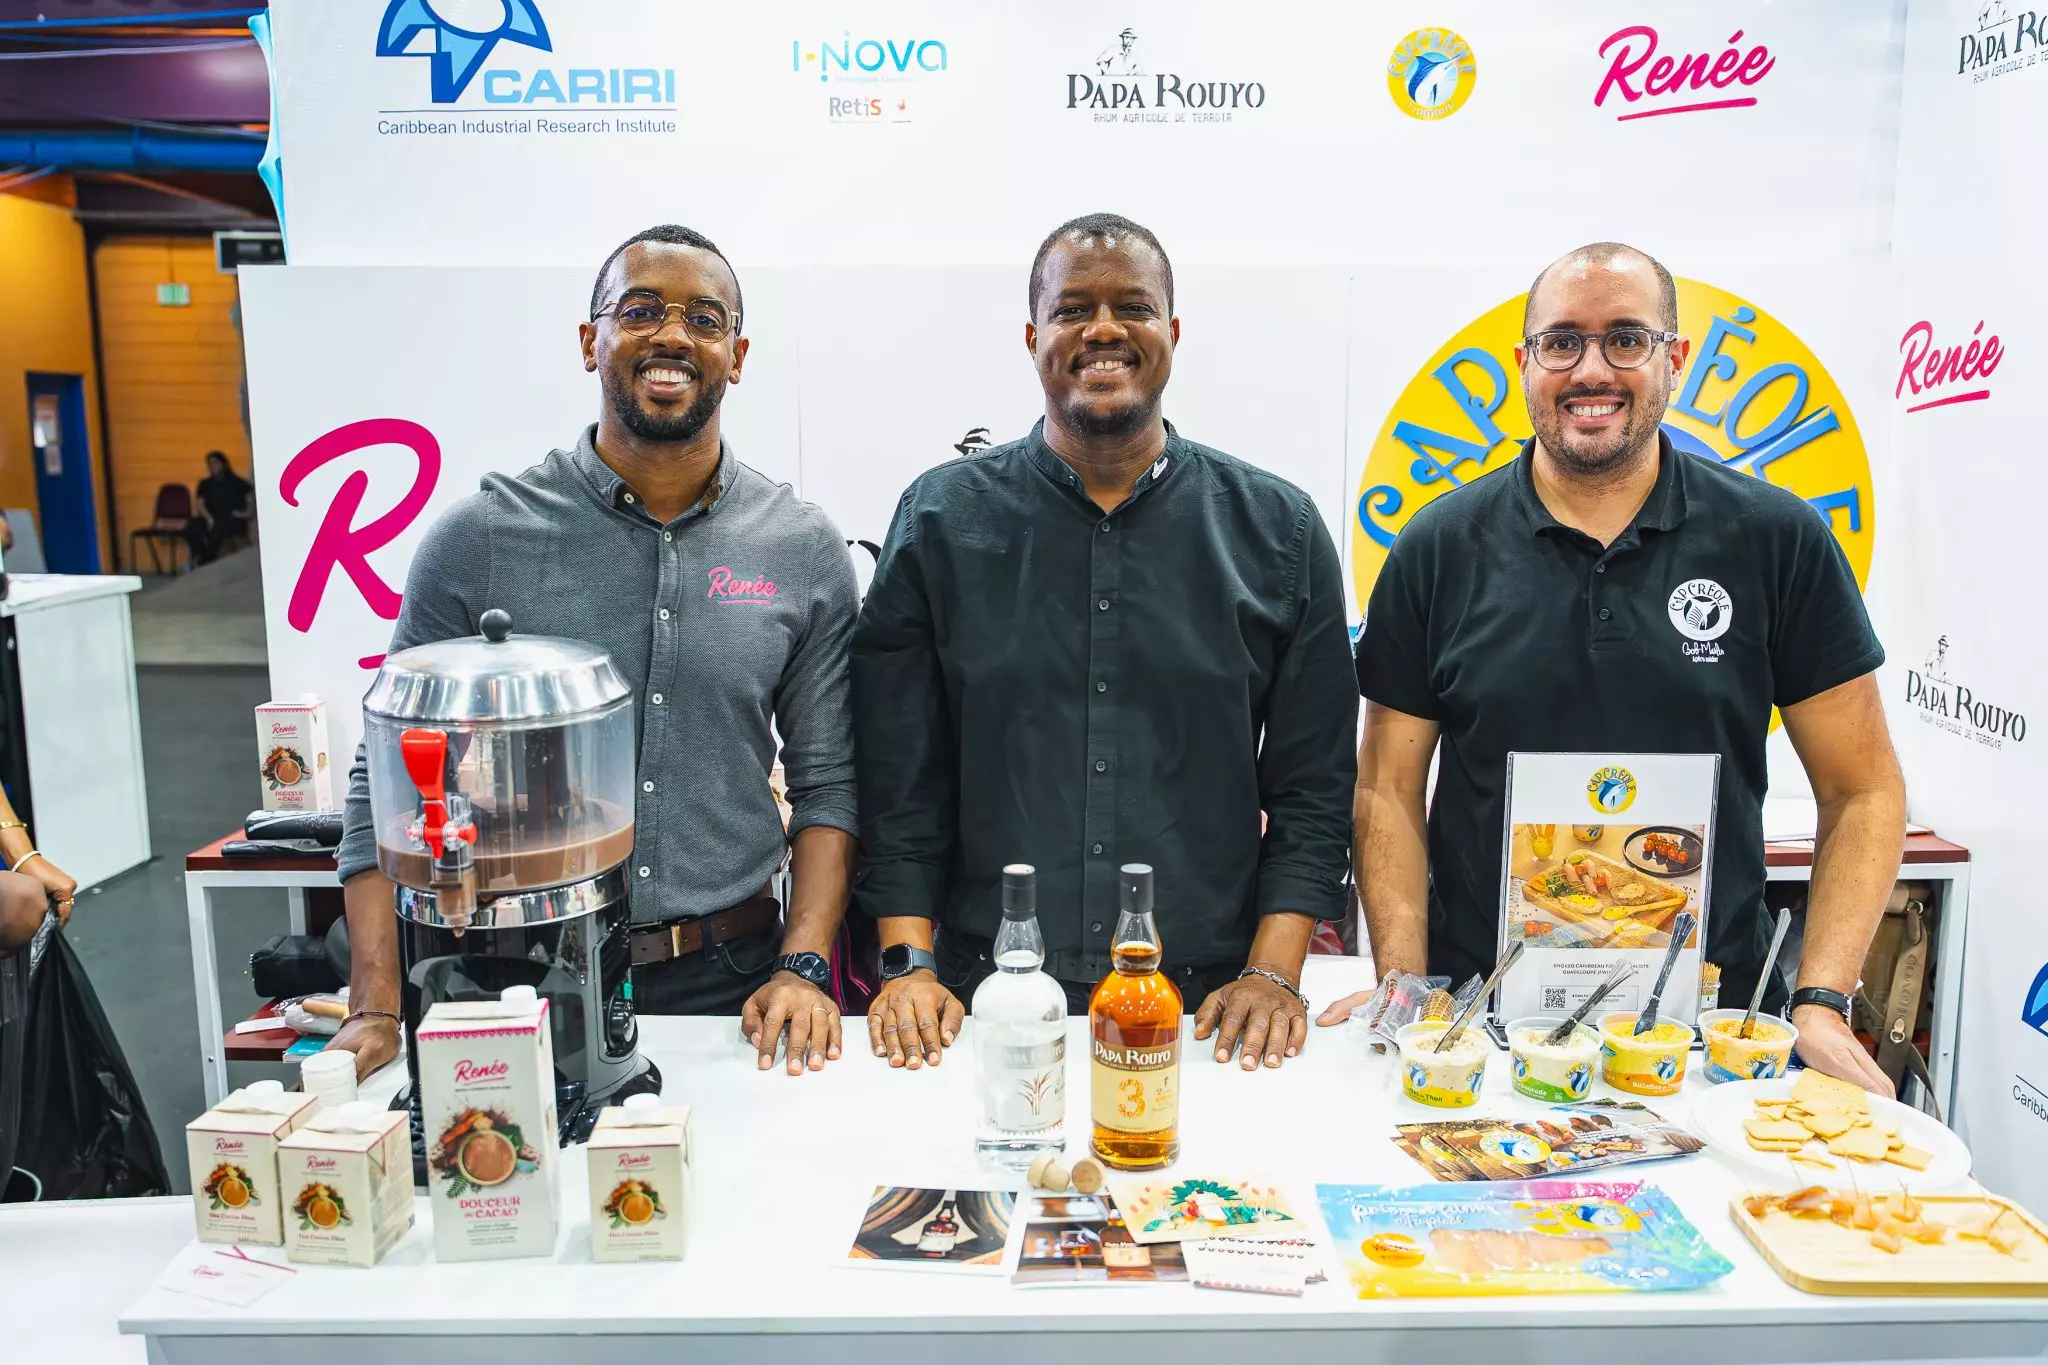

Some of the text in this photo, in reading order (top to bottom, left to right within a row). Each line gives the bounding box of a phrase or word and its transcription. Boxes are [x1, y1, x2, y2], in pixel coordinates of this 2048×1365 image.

[1594, 25, 1776, 107] Renée
[1958, 31, 2008, 75] PAPA
[483, 68, 676, 104] CARIRI
[1066, 74, 1266, 109] PAPA ROUYO
[378, 119, 676, 135] Caribbean Industrial Research Institute
[1094, 113, 1233, 123] RHUM AGRICOLE DE TERROIR
[1896, 320, 2005, 400] Renée
[707, 565, 779, 600] Renée
[1669, 587, 1687, 612] CAP
[1905, 669, 2026, 742] PAPA ROUYO
[1095, 1040, 1123, 1064] PAPA
[1126, 1049, 1171, 1066] ROUYO
[454, 1059, 510, 1083] Renée
[1118, 1078, 1146, 1119] 3
[1426, 1092, 1443, 1103] Thon
[2012, 1084, 2048, 1122] Caribb
[460, 1196, 522, 1209] DOUCEUR
[476, 1207, 518, 1218] CACAO
